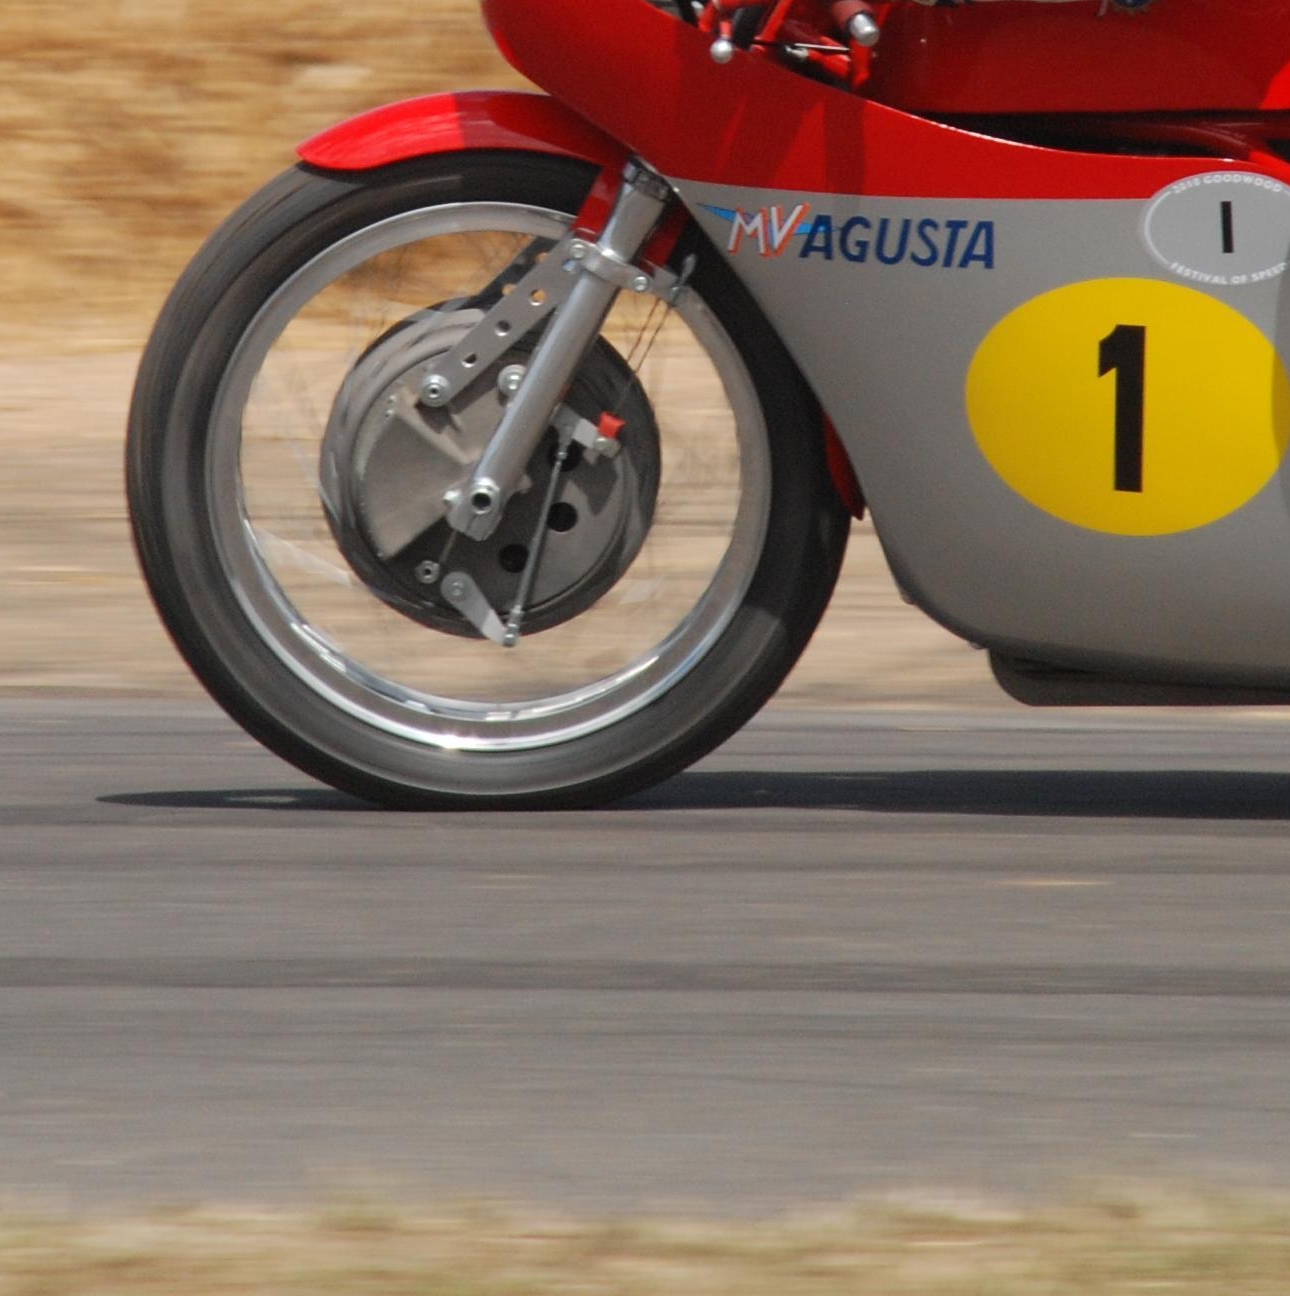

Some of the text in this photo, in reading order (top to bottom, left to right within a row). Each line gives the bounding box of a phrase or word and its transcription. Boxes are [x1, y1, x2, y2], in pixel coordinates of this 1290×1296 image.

[1203, 173, 1283, 193] GOODWOOD
[727, 203, 995, 270] MV AGUSTA
[1170, 262, 1228, 285] FESTIVAL
[1230, 274, 1248, 285] OF
[1098, 324, 1146, 493] 1
